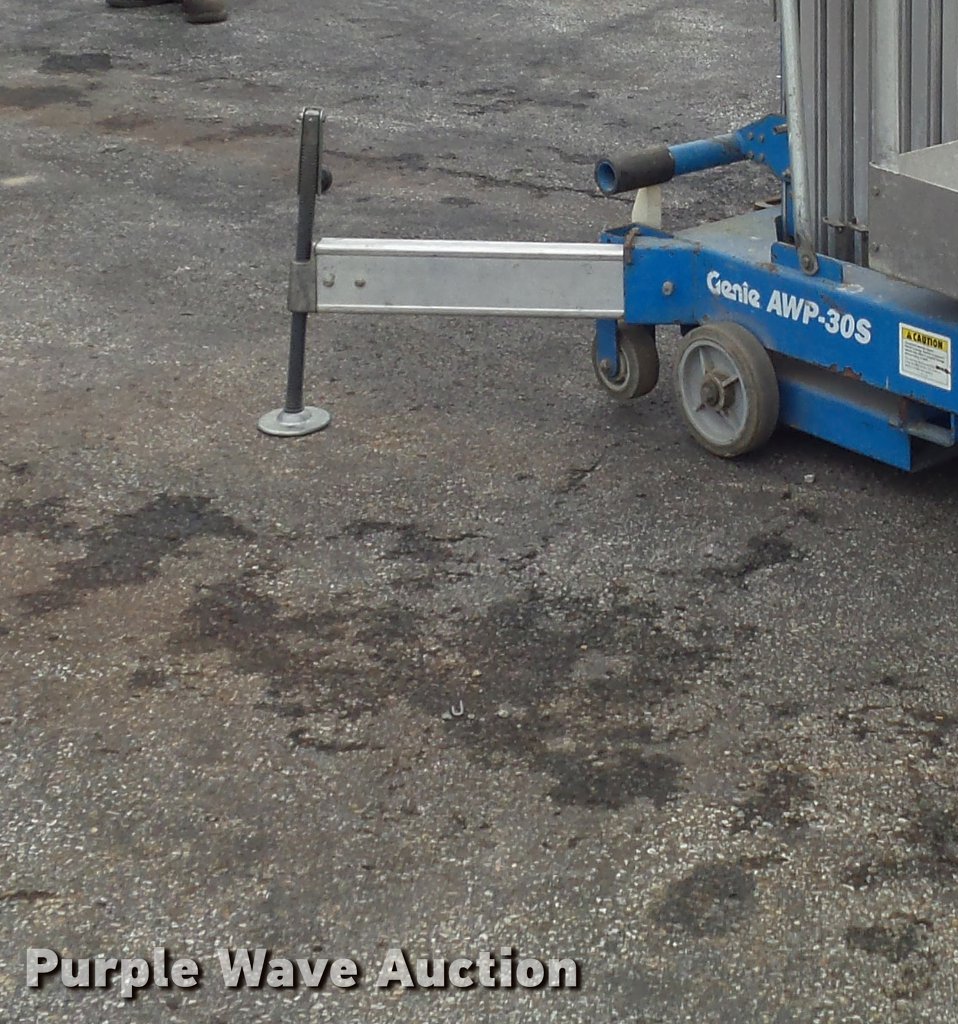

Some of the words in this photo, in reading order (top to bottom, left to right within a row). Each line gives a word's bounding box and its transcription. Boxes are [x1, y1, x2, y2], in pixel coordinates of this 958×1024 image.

[706, 270, 761, 309] Genie
[766, 289, 872, 345] AWP-30S
[913, 332, 943, 349] CAUTION
